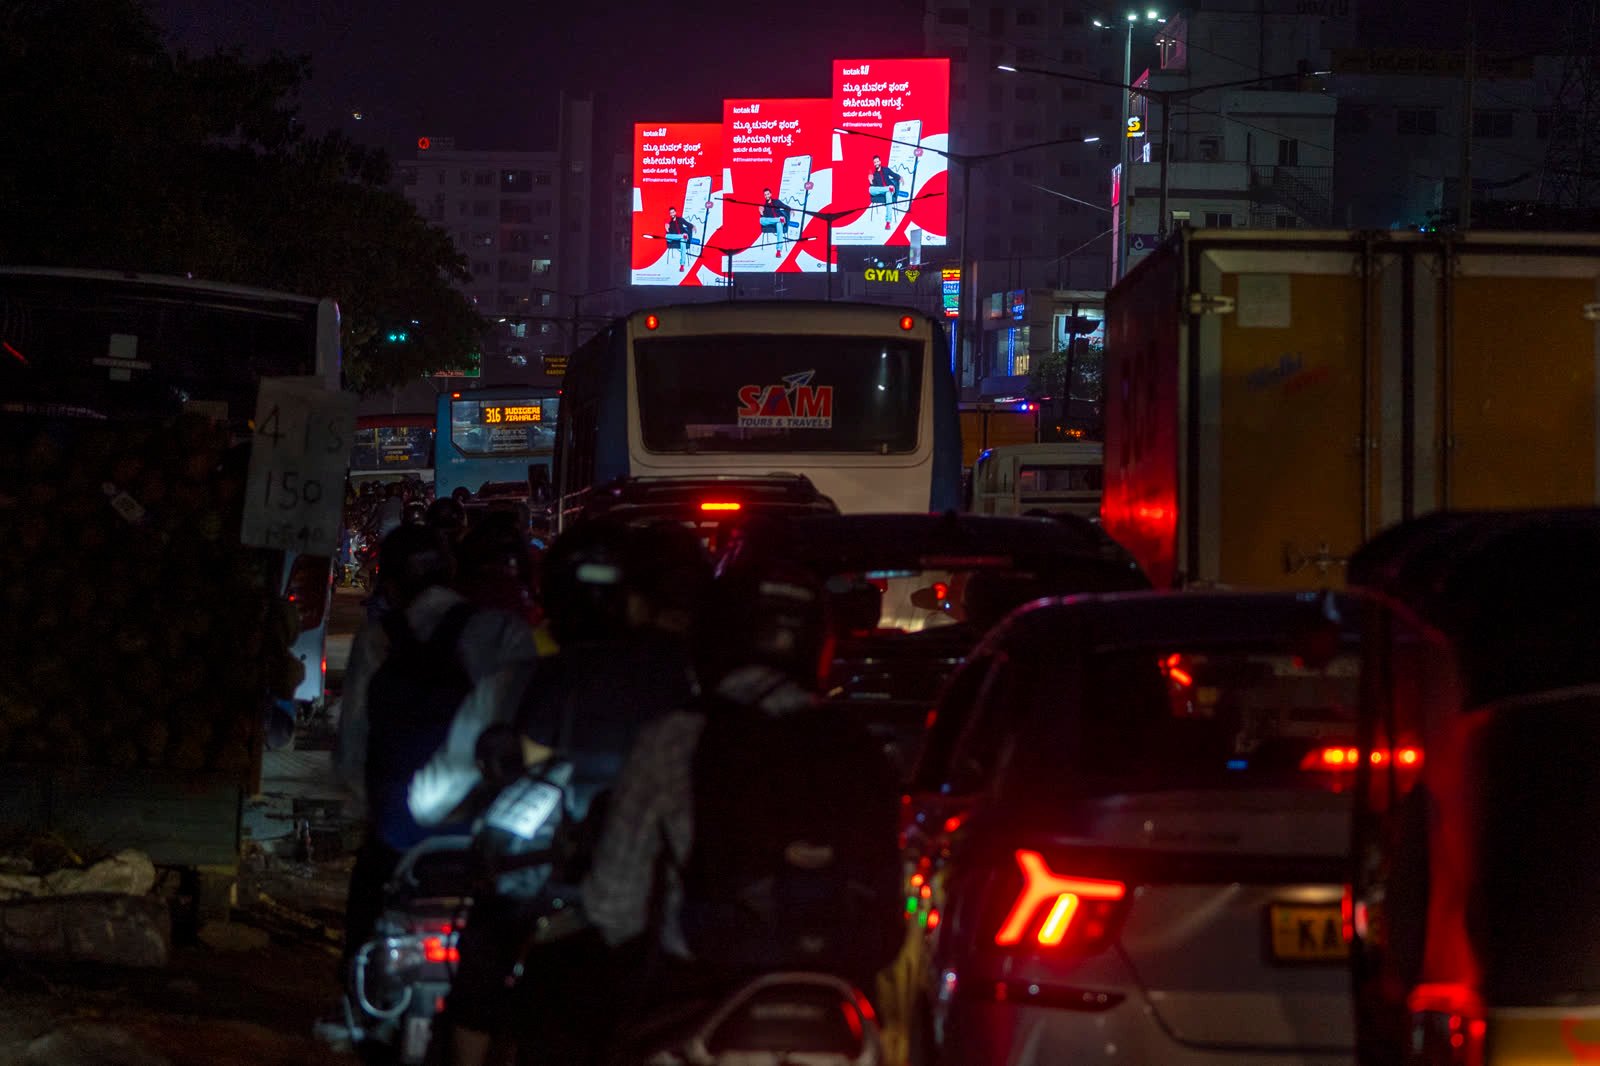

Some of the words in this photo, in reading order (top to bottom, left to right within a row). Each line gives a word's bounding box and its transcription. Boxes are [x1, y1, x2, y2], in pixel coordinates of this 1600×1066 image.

[864, 268, 899, 282] GYM
[738, 385, 833, 417] SAM
[258, 405, 286, 448] 4
[485, 407, 501, 423] 316
[741, 418, 773, 426] TOURS
[776, 418, 783, 426] &
[785, 418, 830, 427] TRAVELS
[264, 471, 322, 510] 150
